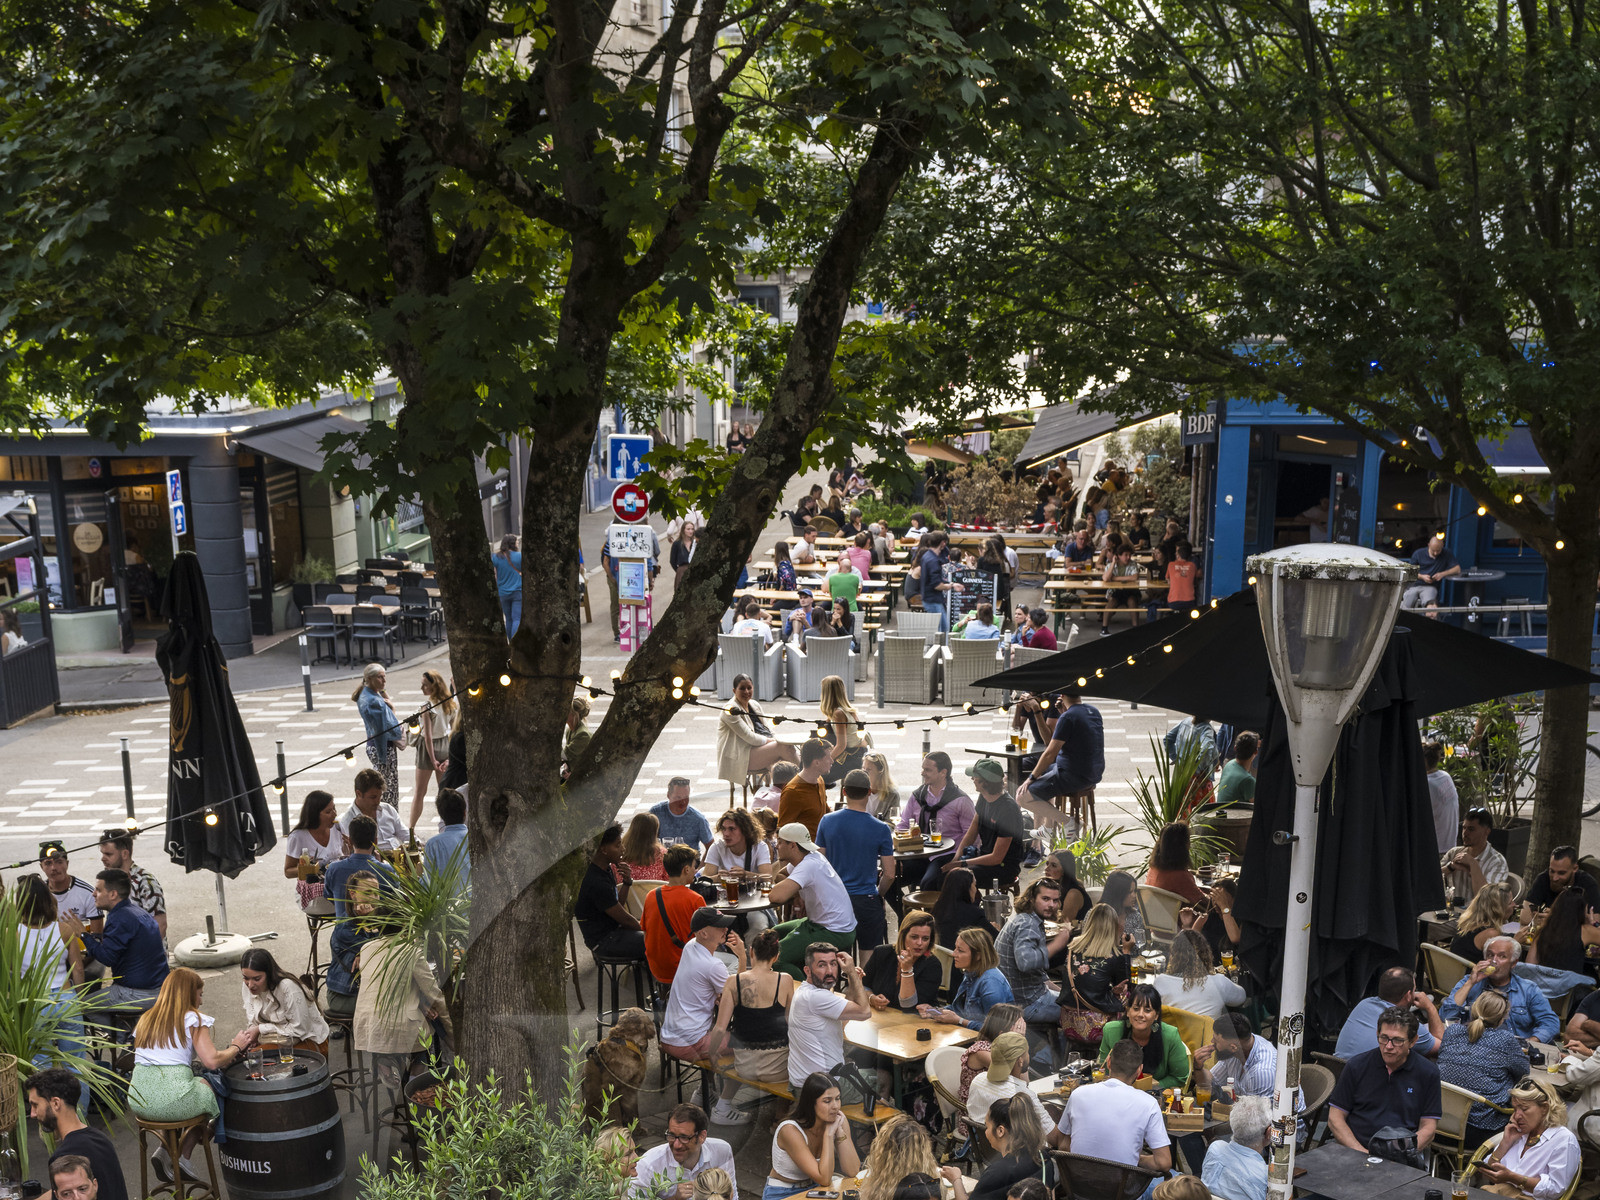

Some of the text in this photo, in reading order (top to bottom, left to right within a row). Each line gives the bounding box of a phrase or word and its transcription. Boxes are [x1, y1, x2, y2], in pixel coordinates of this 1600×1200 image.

[1186, 413, 1217, 435] BDF
[615, 531, 644, 539] INTEDIT
[220, 1150, 272, 1174] BUSHMILLS
